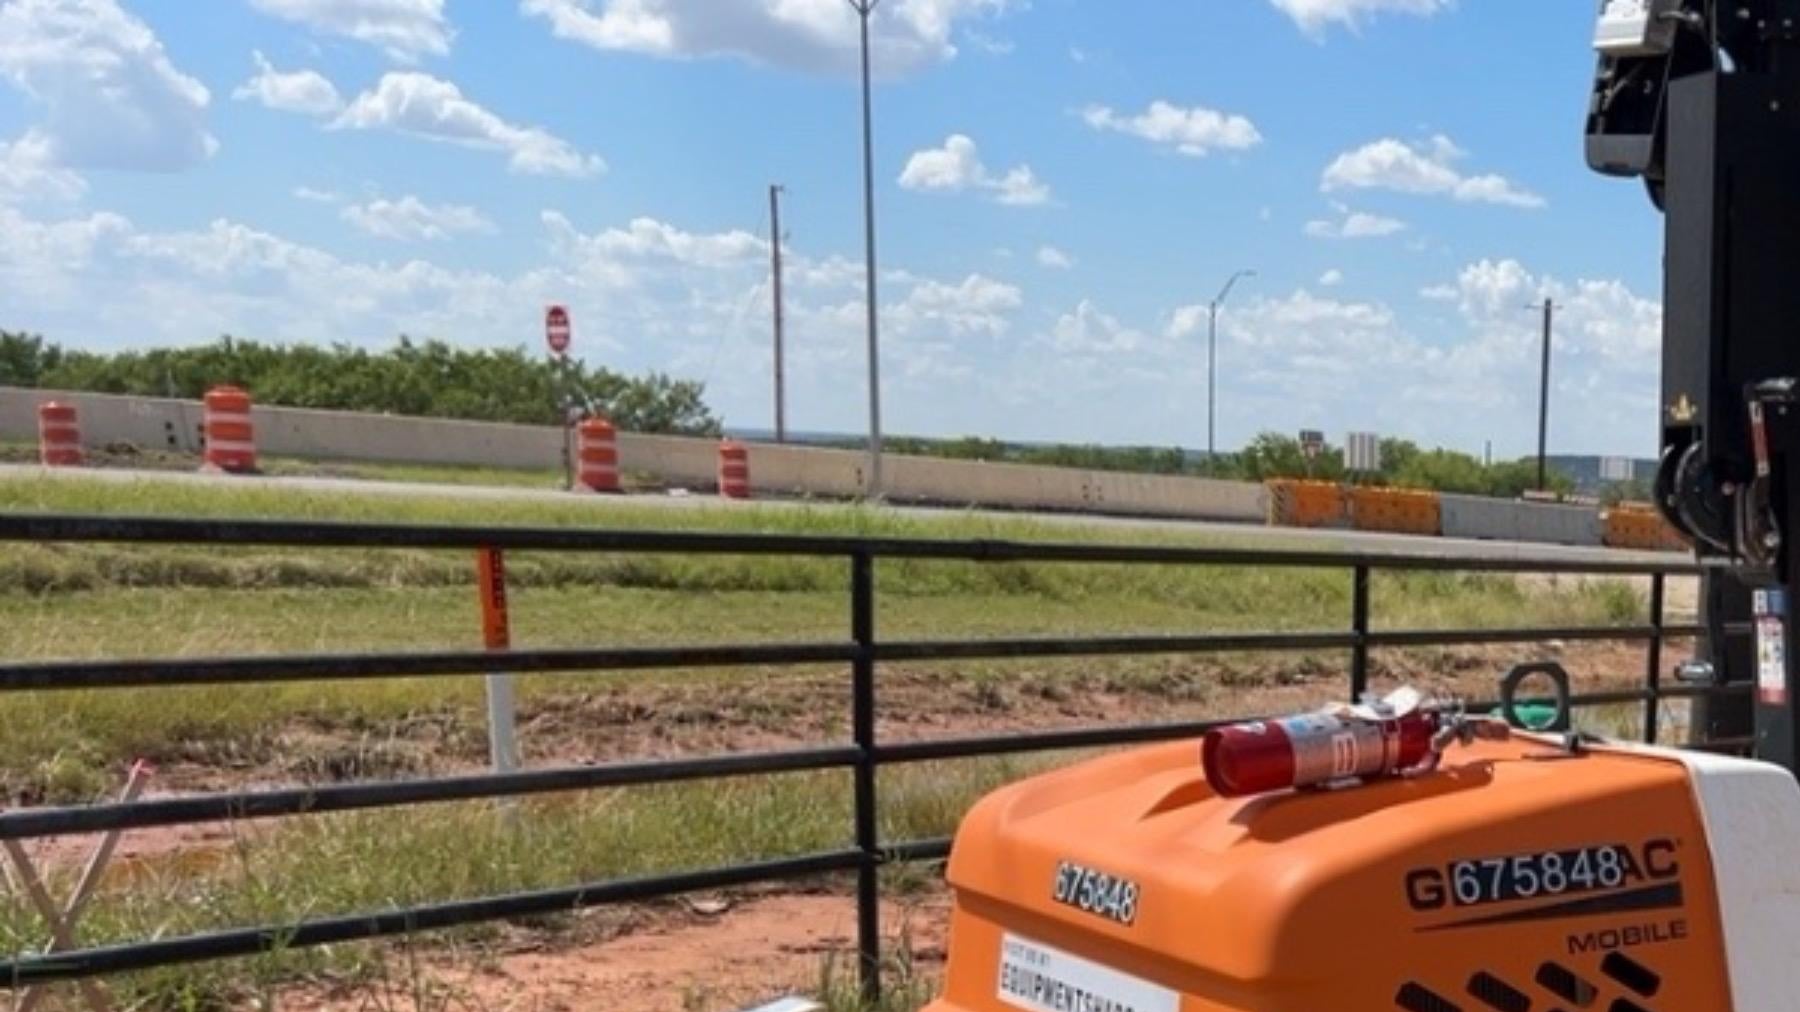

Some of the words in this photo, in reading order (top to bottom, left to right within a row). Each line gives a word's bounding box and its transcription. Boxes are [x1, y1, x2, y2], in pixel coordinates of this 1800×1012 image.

[1055, 860, 1135, 924] 675848
[1453, 846, 1622, 904] 675848
[1567, 919, 1687, 954] MOBILE
